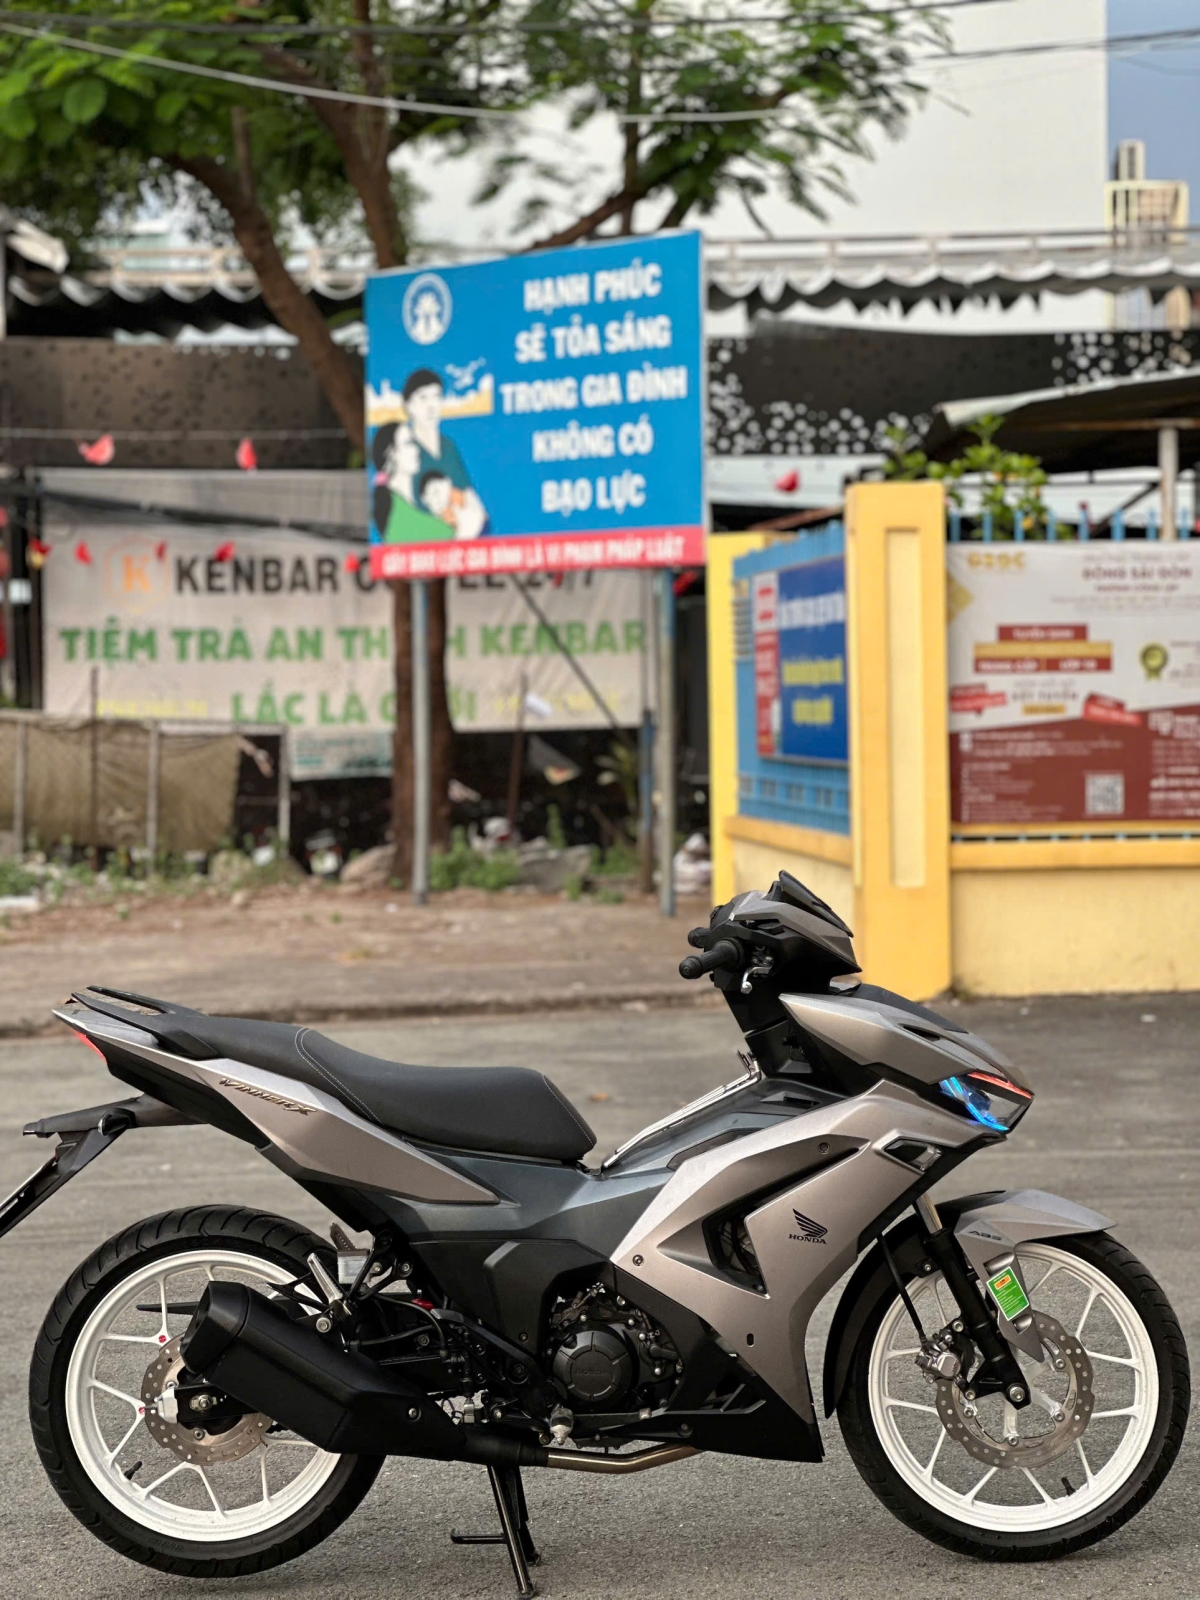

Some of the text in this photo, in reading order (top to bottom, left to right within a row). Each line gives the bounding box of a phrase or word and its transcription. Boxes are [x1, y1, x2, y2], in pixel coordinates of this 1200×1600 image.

[523, 257, 663, 316] HẠNH PHÚC
[551, 313, 601, 359] TỎA
[604, 310, 673, 355] SÁNG
[499, 361, 689, 415] TRONG GIA ĐÌNH
[532, 412, 655, 463] KHÔNG CÓ
[541, 468, 647, 518] BẠO LỰC
[175, 556, 340, 595] KENBAR
[266, 625, 323, 661] AN
[788, 1233, 828, 1245] HONDA
